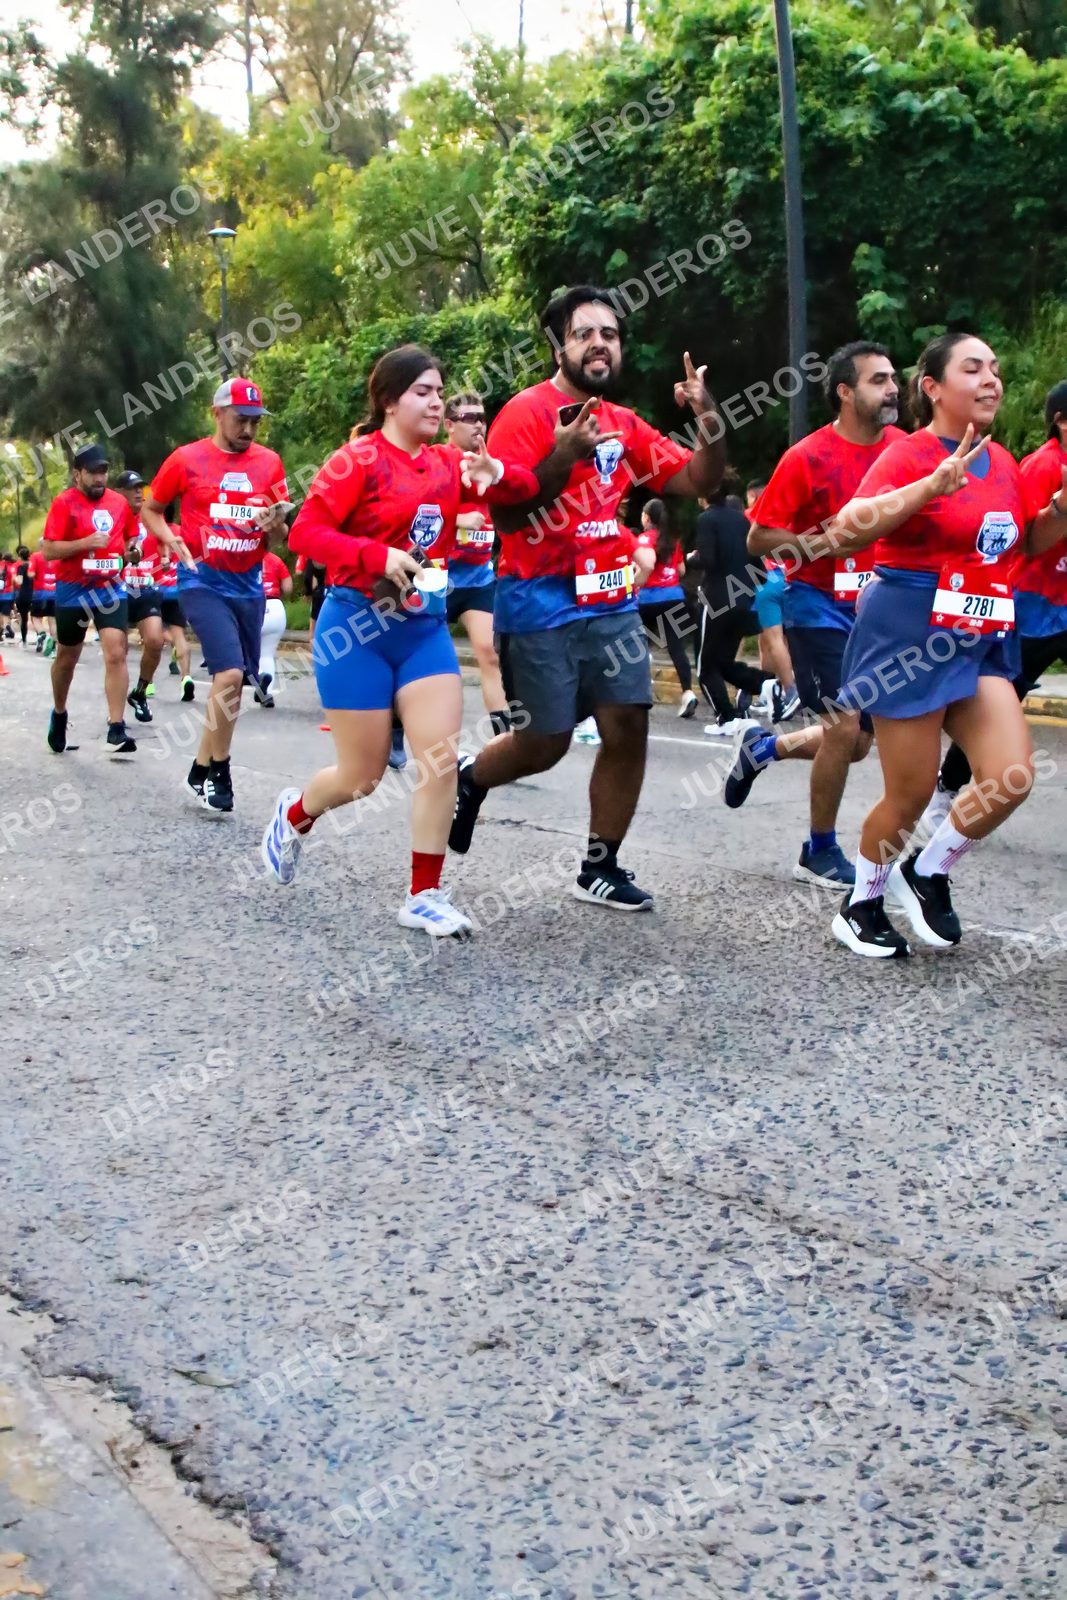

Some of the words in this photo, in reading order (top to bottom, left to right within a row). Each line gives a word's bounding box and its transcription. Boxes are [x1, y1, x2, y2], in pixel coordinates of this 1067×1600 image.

[230, 506, 252, 519] 1784
[599, 570, 623, 590] 2440
[962, 596, 995, 617] 2781
